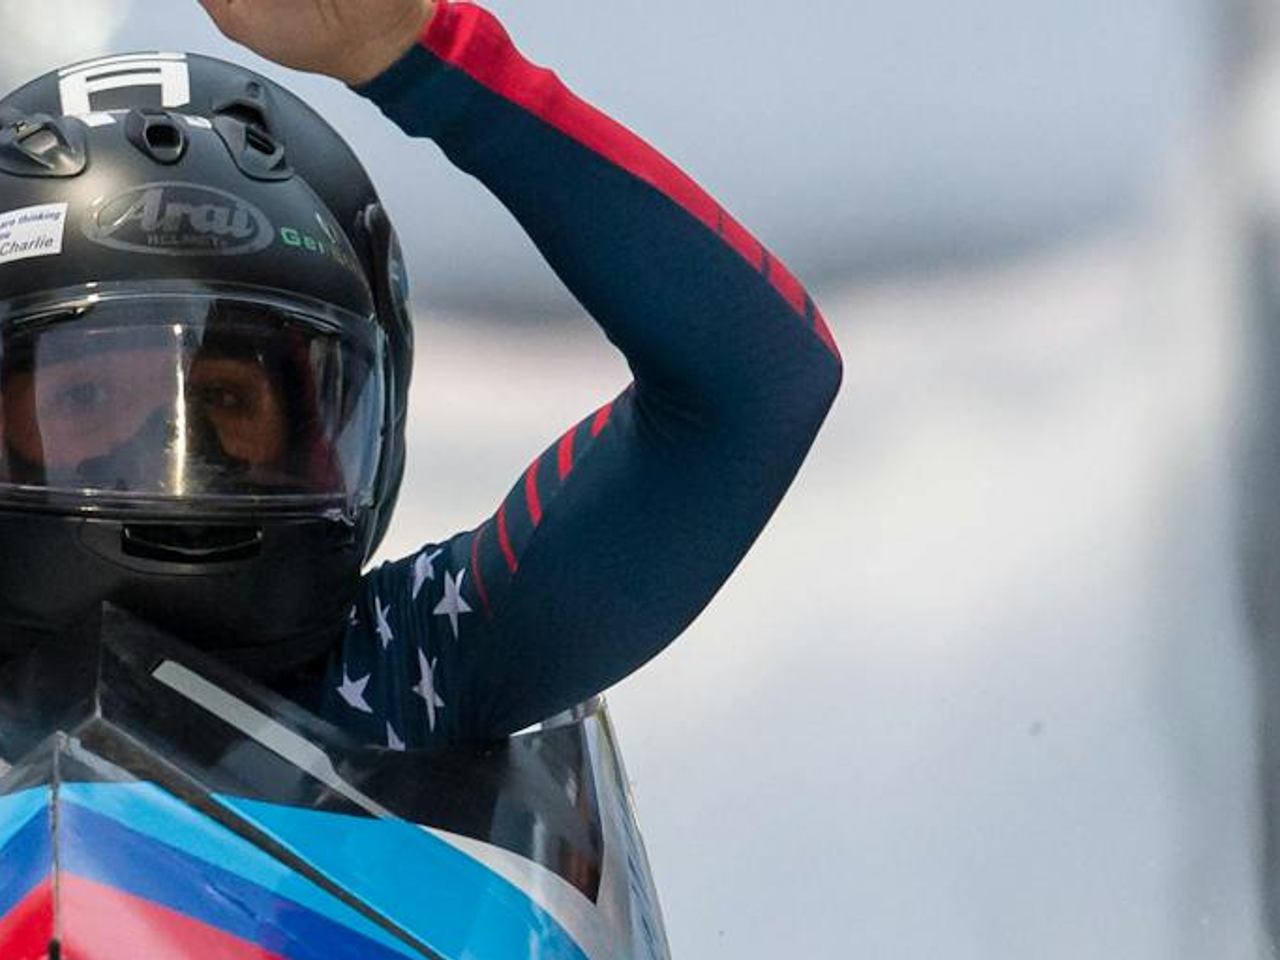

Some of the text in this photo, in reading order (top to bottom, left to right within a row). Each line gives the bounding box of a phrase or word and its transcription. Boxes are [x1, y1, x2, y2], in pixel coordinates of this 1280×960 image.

[0, 219, 16, 230] are
[18, 212, 61, 223] thinking
[103, 187, 257, 238] Arai
[0, 237, 54, 257] Charlie
